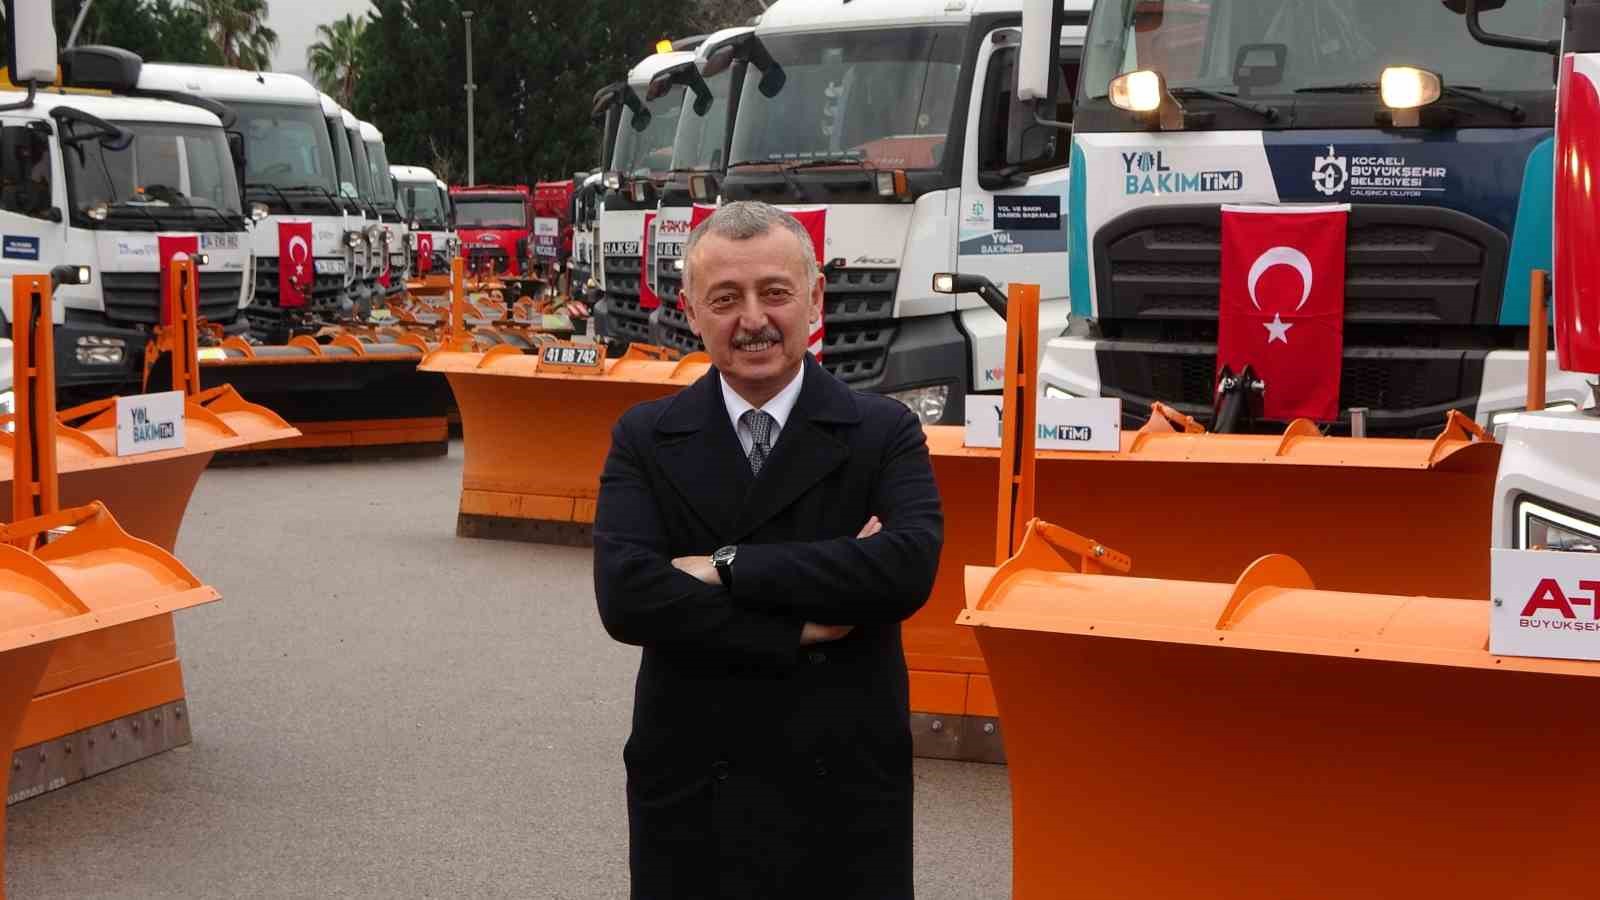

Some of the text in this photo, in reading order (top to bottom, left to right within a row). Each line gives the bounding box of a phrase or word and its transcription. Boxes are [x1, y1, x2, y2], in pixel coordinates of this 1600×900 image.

[1122, 151, 1170, 173] YOL
[1351, 166, 1447, 178] BÜYÜKŞEHİR
[1350, 177, 1422, 187] BELEDİYESİ
[546, 348, 560, 361] 41
[576, 349, 596, 364] 742
[131, 407, 150, 425] YOL
